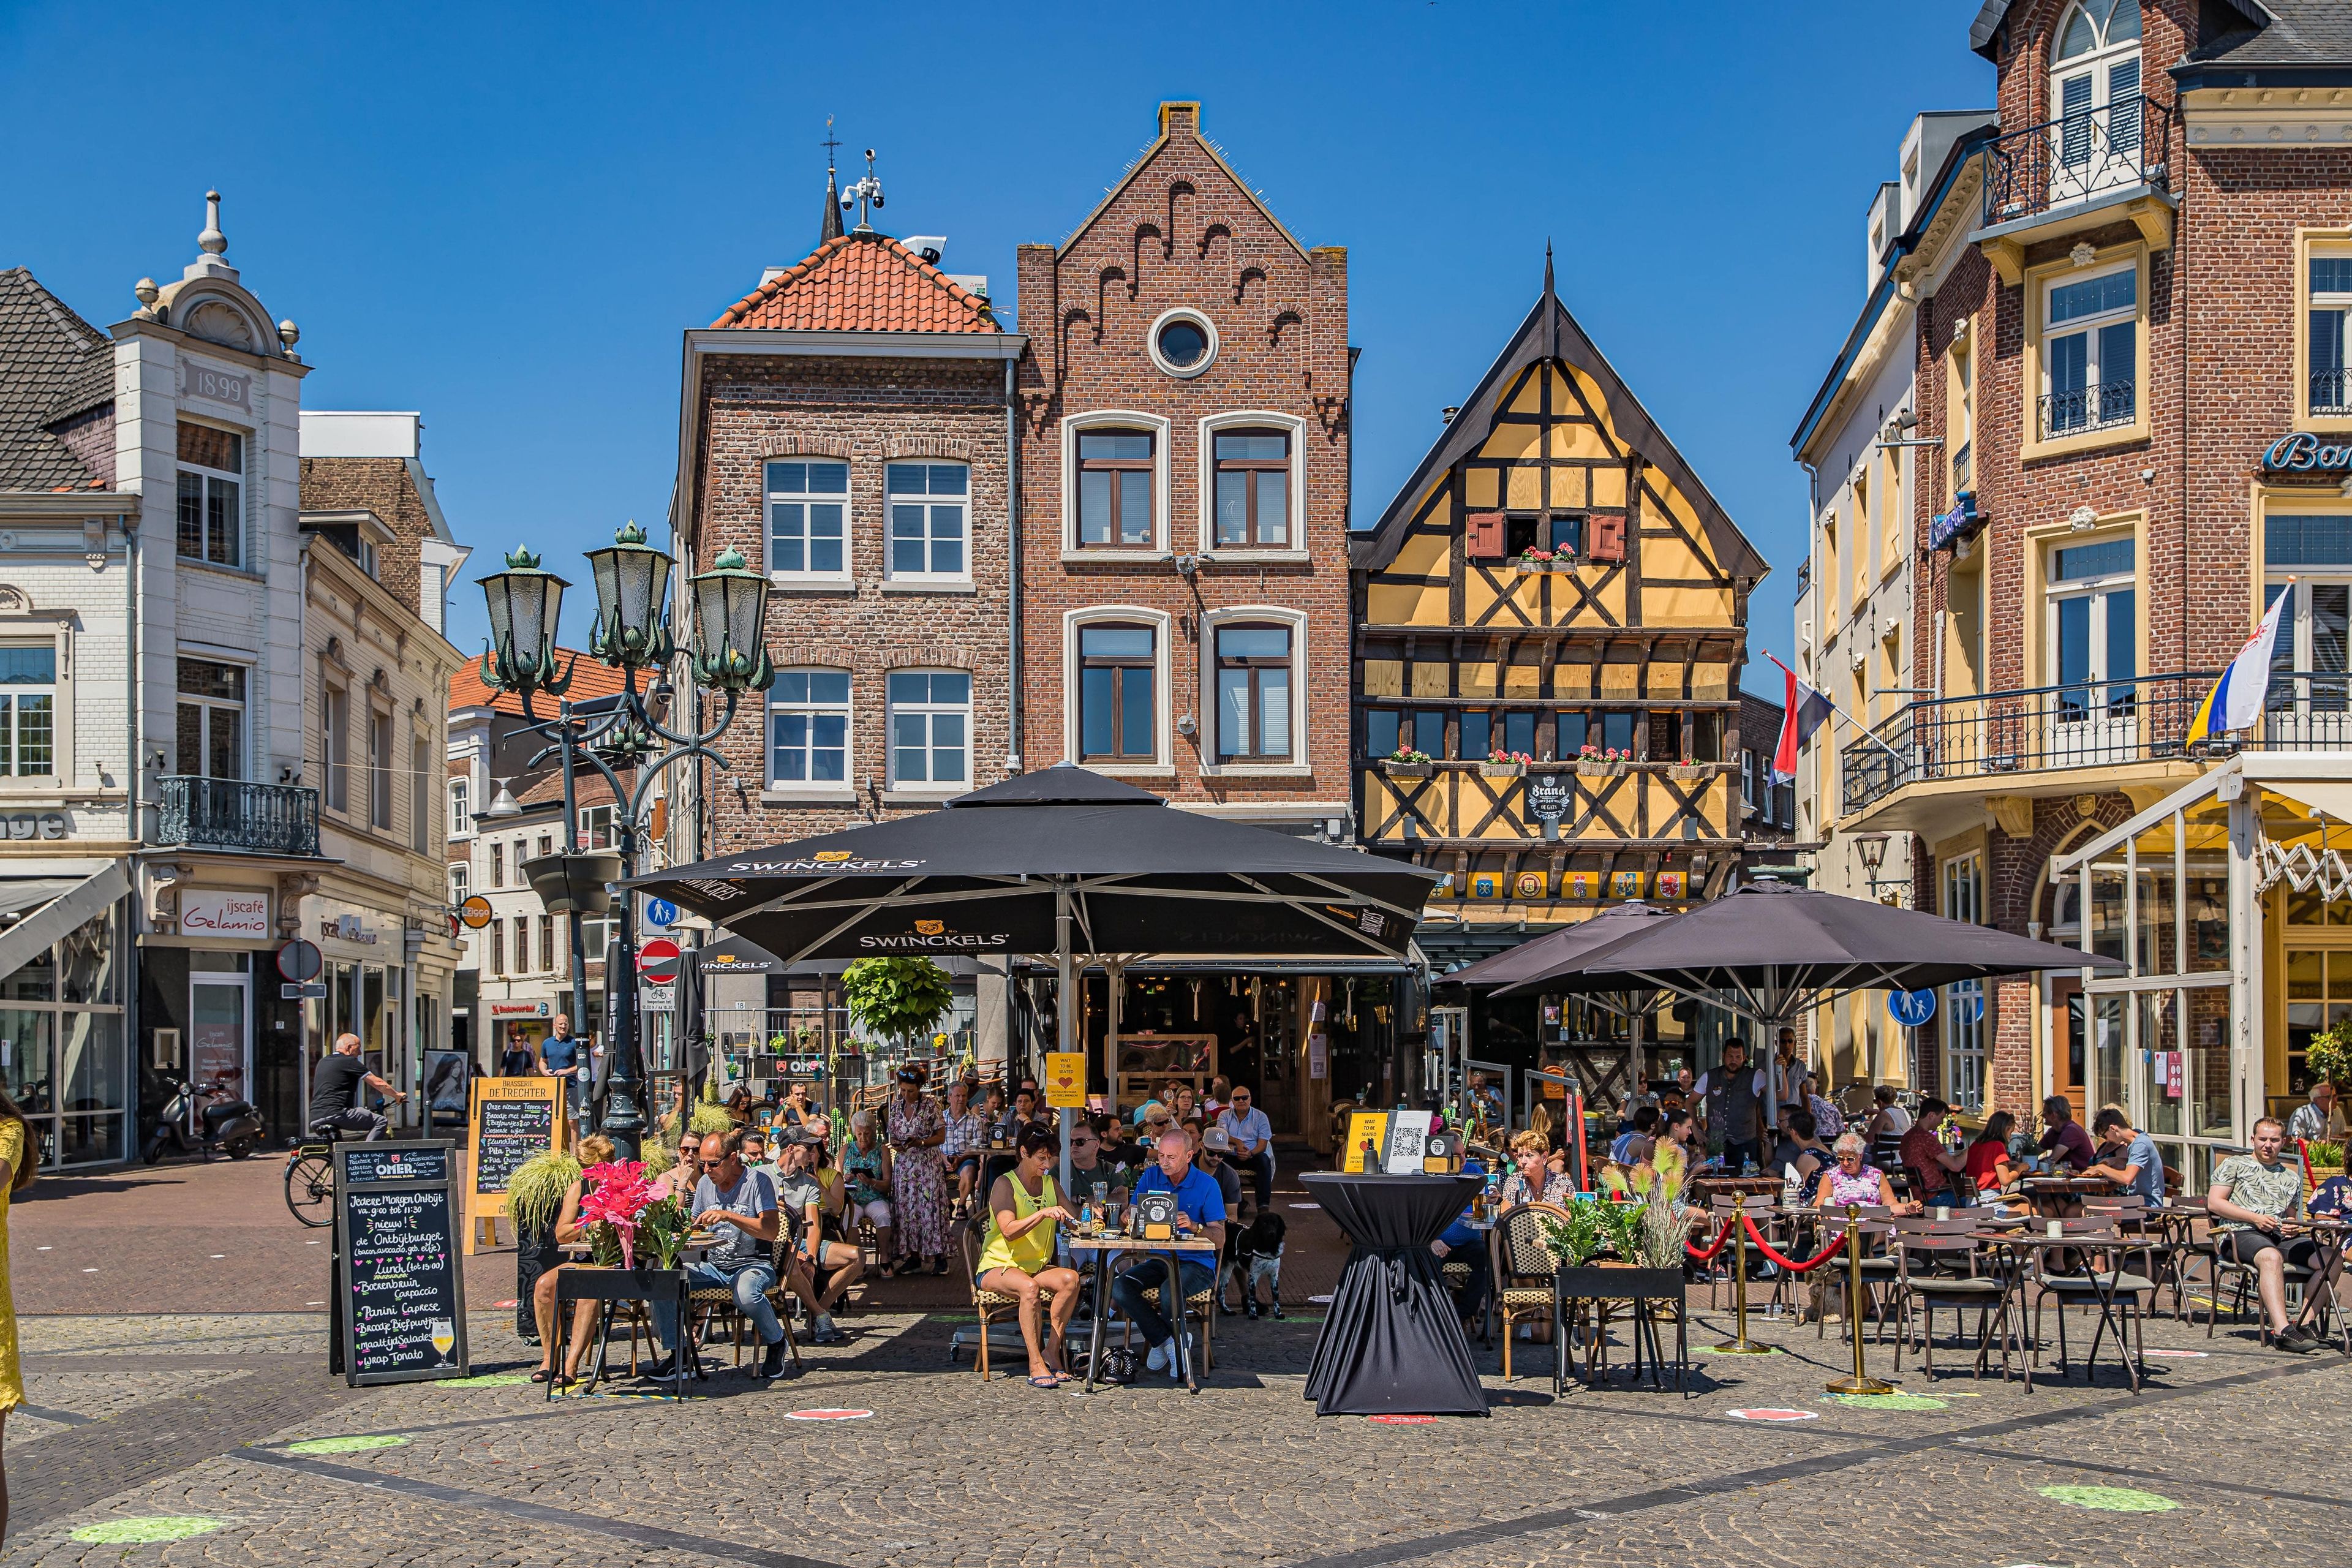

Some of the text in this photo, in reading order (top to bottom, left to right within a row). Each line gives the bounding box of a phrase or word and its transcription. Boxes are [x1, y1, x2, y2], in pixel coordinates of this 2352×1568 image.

[197, 372, 241, 402] 1899
[2262, 432, 2352, 472] Ba
[1532, 785, 1566, 796] Brand
[728, 860, 927, 872] SWINCKELS'
[227, 899, 263, 915] ijscafé
[184, 907, 265, 931] Gelamio
[859, 934, 1009, 948] SWINCKELS'
[790, 1060, 824, 1072] OM
[489, 1088, 546, 1097] DE TRECHTER
[1216, 1133, 1223, 1141] NY
[389, 1206, 402, 1215] tot
[404, 1205, 422, 1215] 11:30
[356, 1237, 368, 1246] de
[375, 1264, 406, 1274] Lunch
[394, 1286, 438, 1299] Carpaccio
[361, 1302, 441, 1318] Panini Caprese
[356, 1322, 391, 1334] Broodje
[364, 1349, 423, 1365] Wrap Tonato
